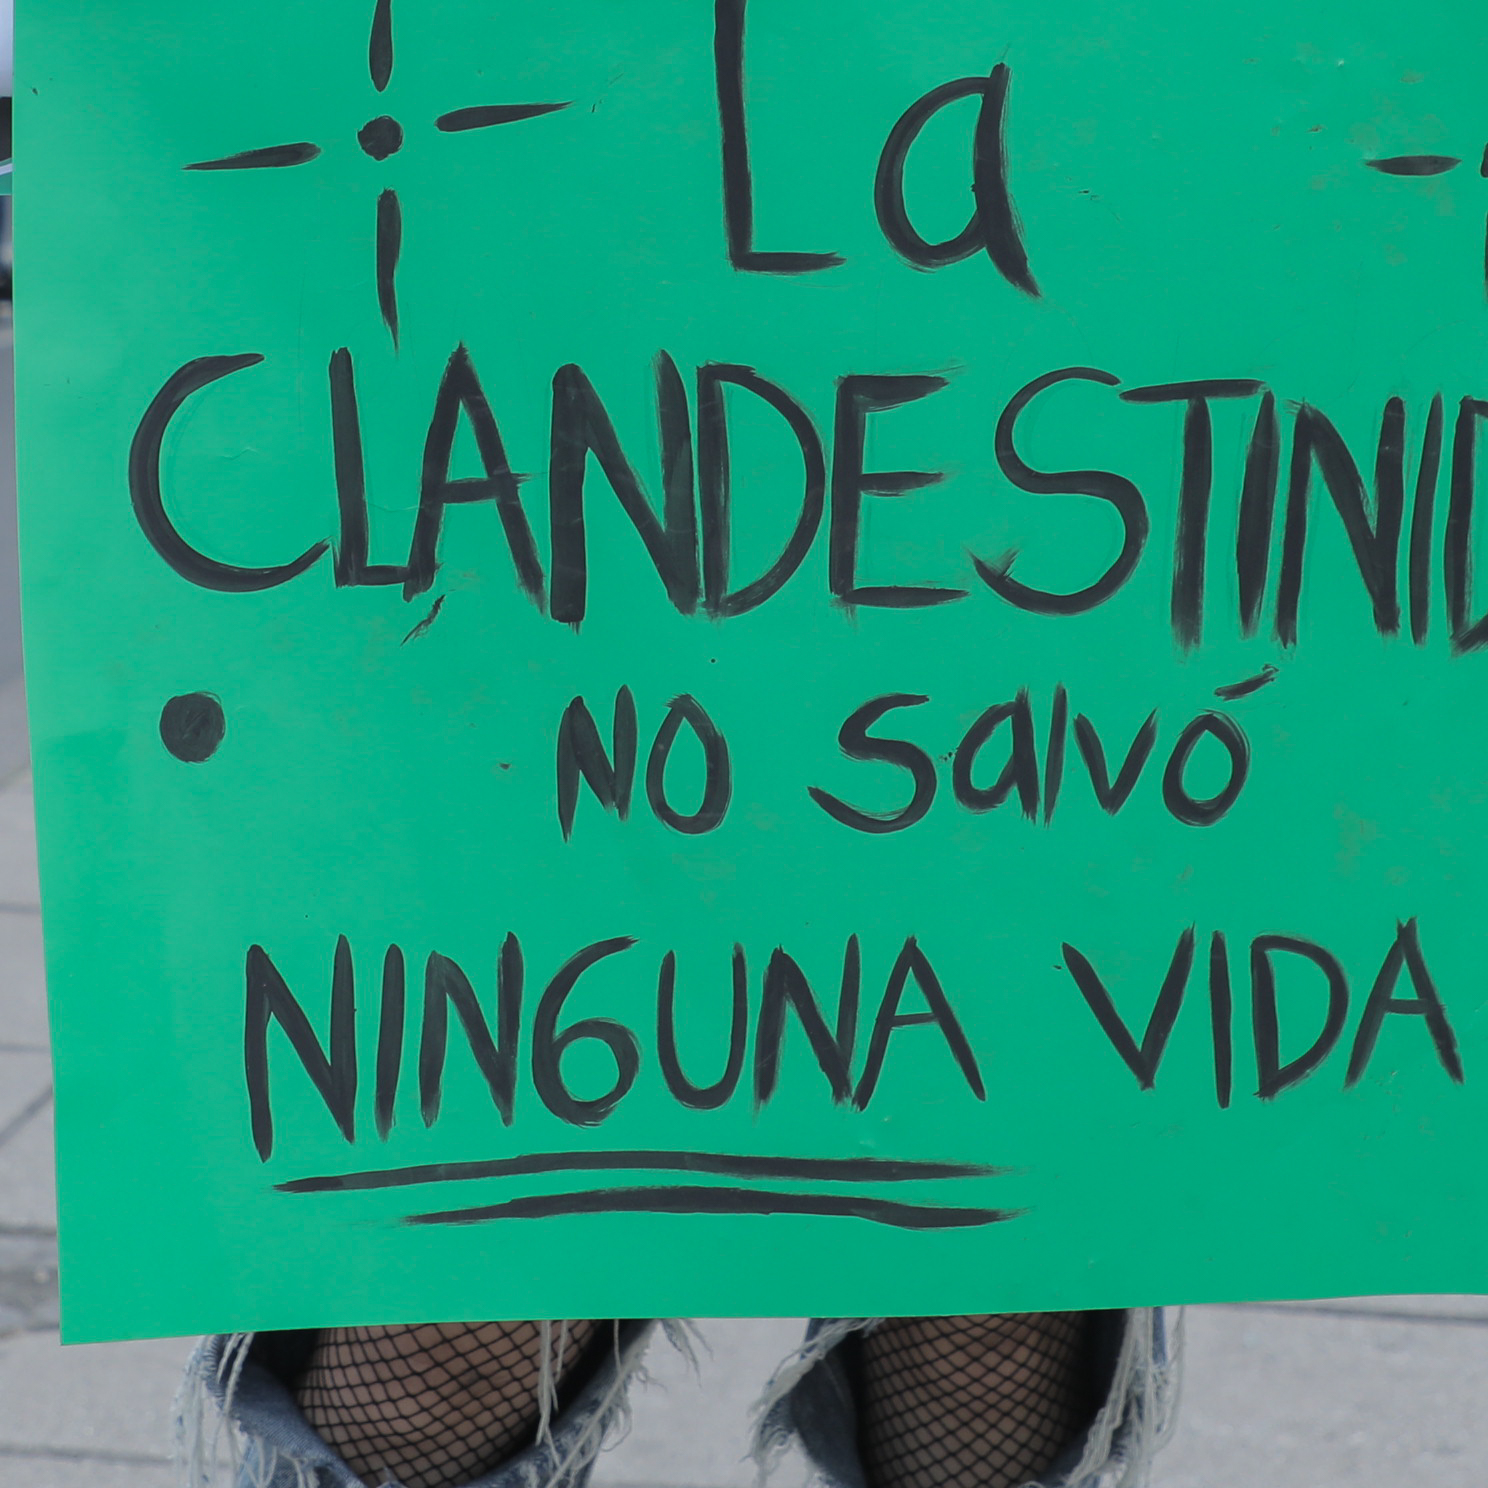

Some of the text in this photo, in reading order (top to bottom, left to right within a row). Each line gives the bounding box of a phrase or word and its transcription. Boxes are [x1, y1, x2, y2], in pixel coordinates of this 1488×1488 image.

[555, 683, 733, 842] NO
[244, 916, 1465, 1164] NINGUNA VIDA
